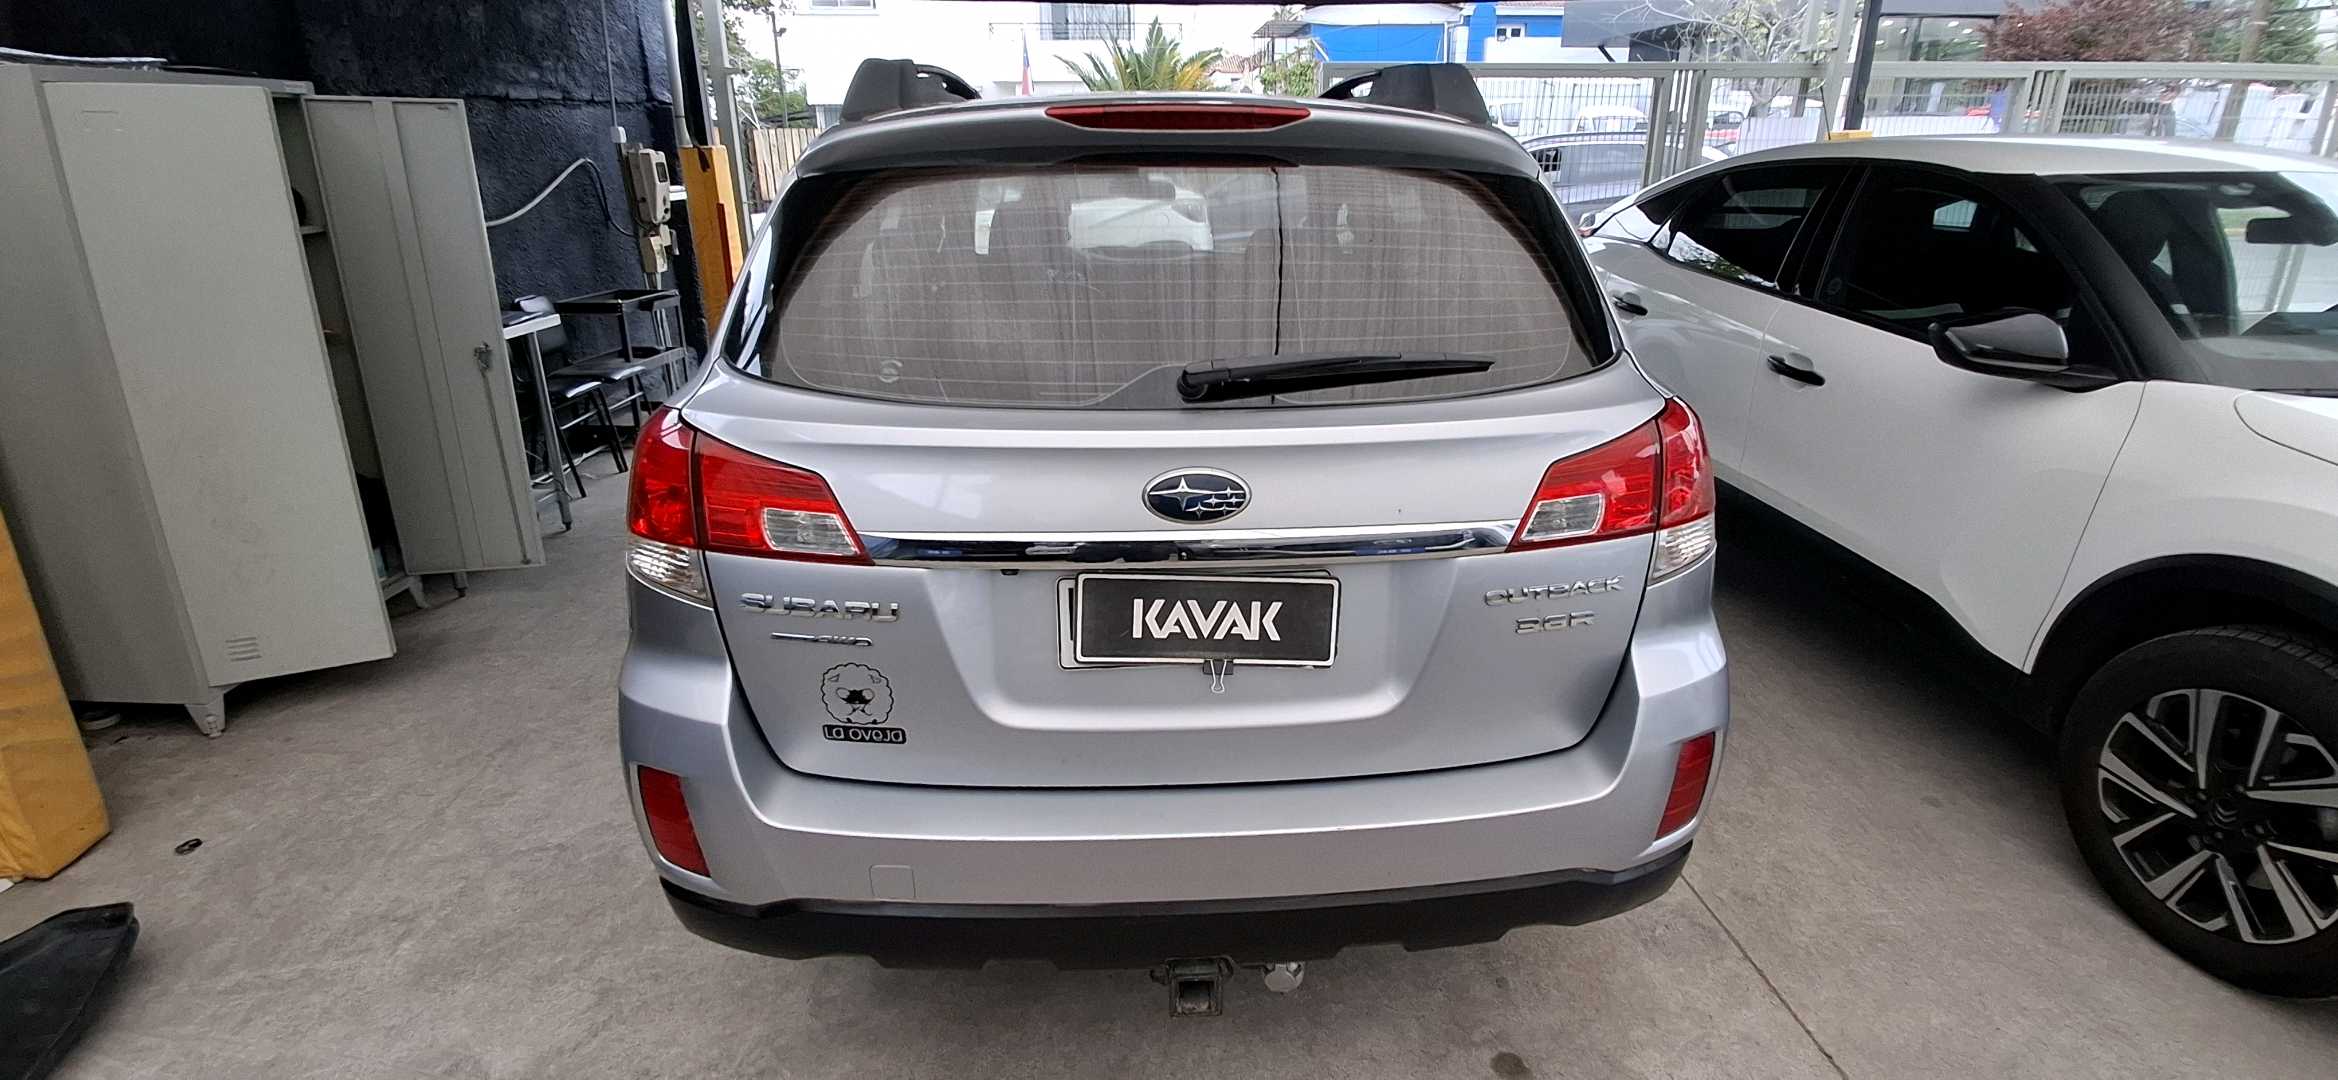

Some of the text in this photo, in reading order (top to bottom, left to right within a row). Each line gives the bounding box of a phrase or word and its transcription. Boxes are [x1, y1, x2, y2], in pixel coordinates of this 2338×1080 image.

[1484, 575, 1624, 606] OUTBACK
[740, 592, 899, 622] SUBARU
[1132, 598, 1283, 641] KAVAK
